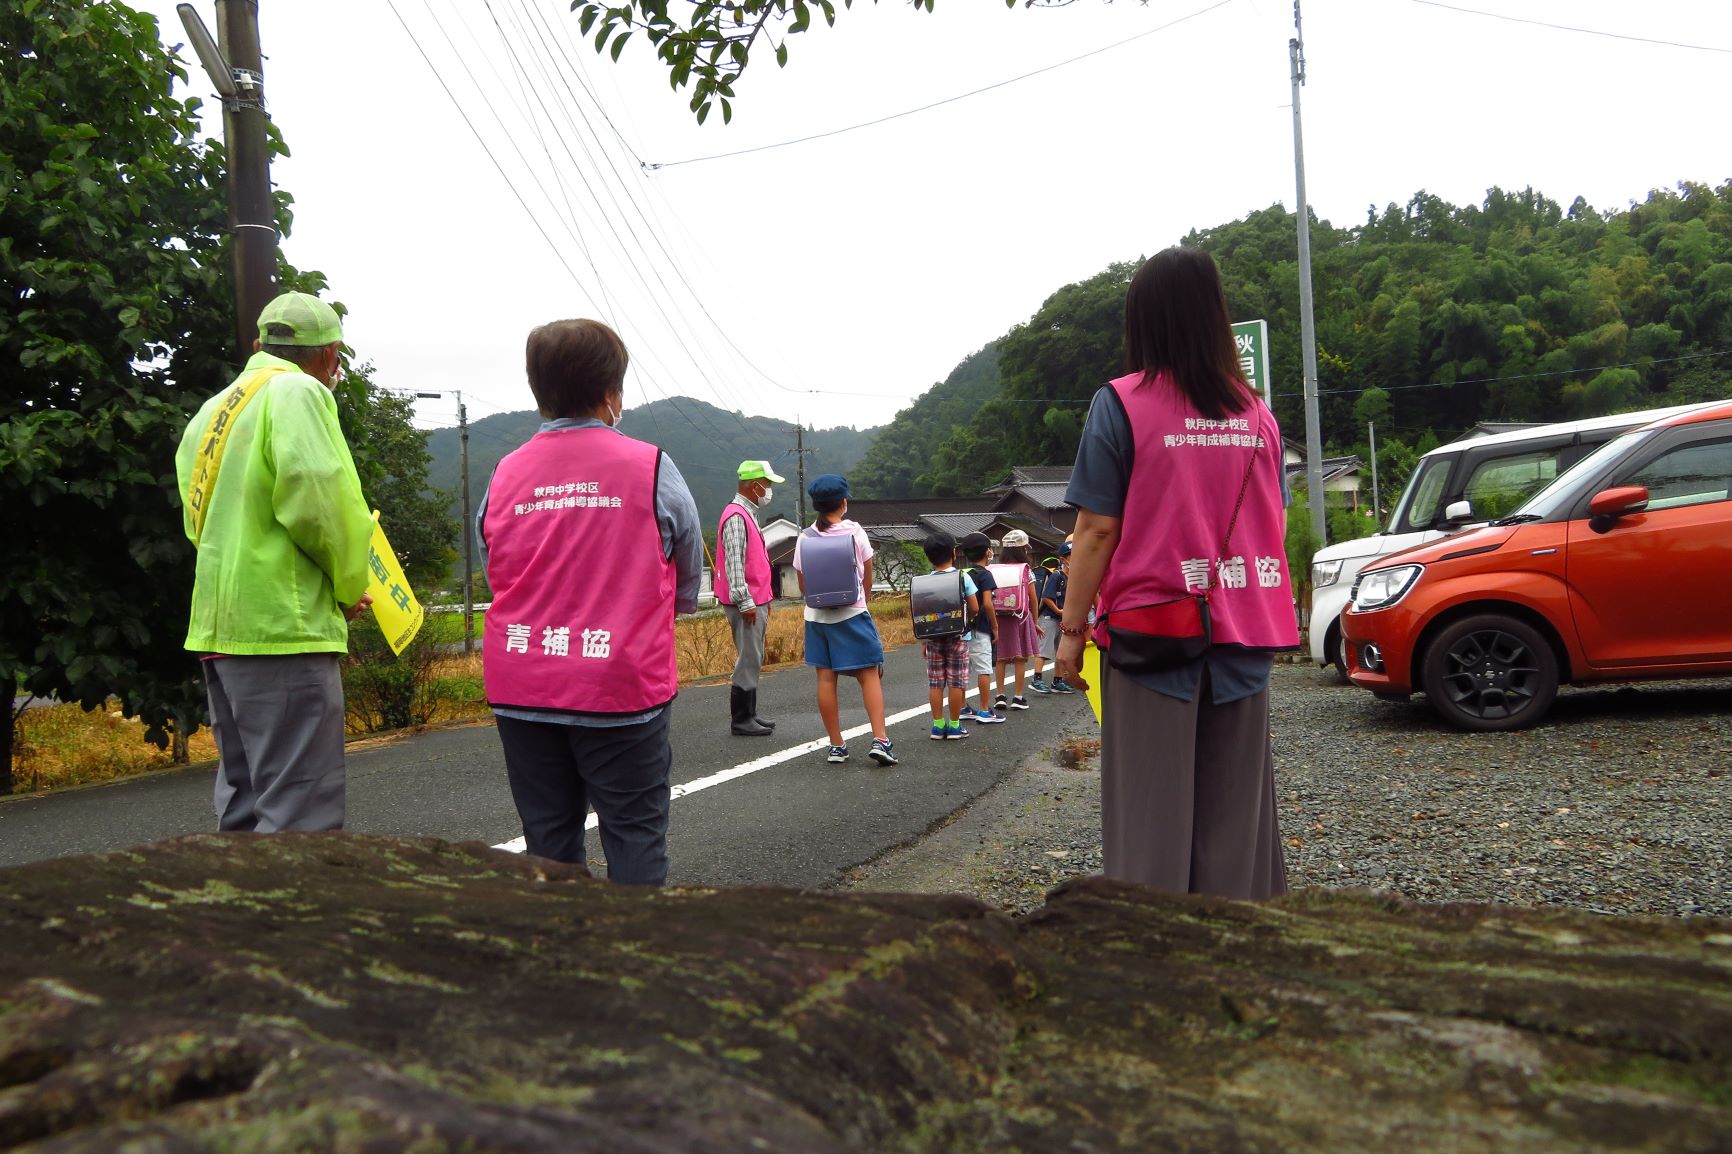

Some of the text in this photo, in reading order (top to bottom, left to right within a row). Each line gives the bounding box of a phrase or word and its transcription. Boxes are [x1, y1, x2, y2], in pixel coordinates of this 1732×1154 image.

[1233, 333, 1257, 389] 秋月
[1184, 417, 1250, 431] 秋月中学校区
[534, 481, 600, 498] 秋月中学校区
[514, 496, 622, 515] 青少年育成補導協議会
[506, 623, 611, 659] 青補協
